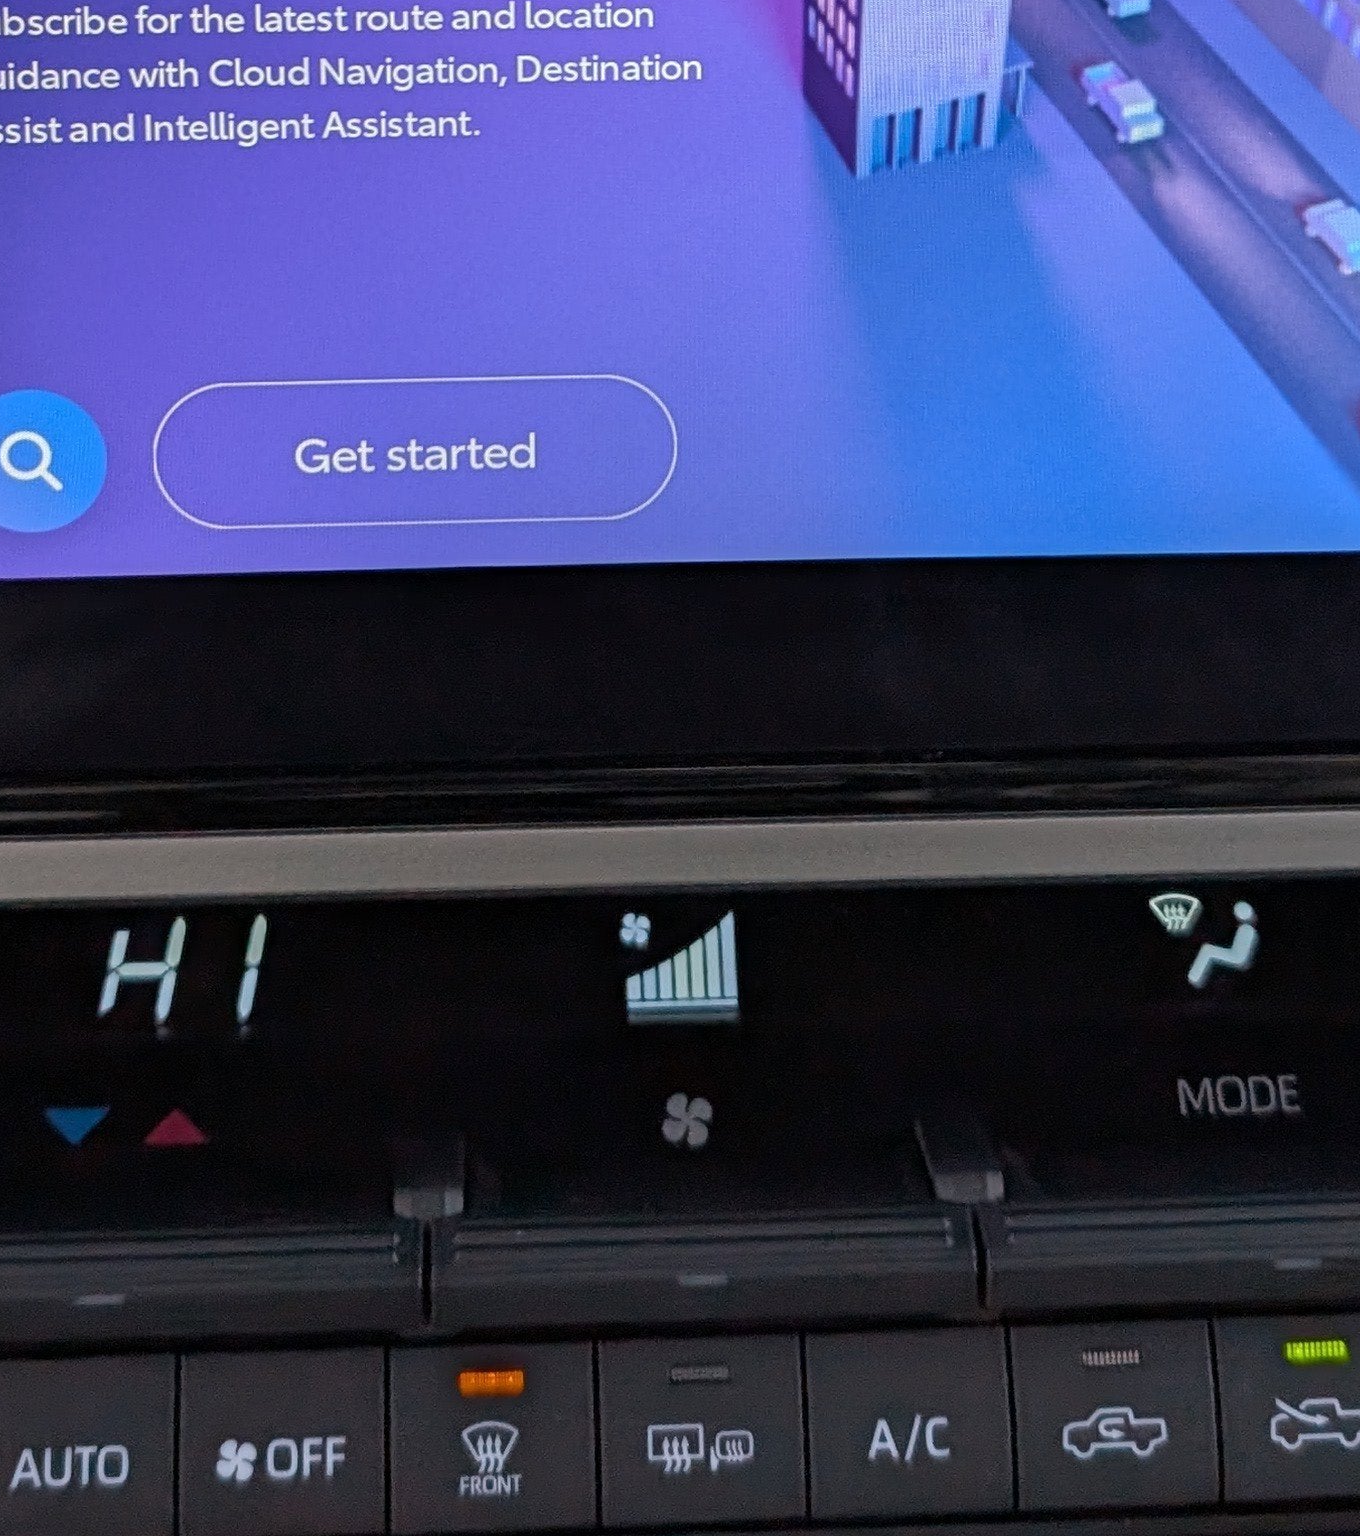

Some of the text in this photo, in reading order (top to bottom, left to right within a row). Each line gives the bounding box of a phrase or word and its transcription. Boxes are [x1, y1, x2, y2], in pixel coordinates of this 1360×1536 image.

[134, 4, 183, 34] for
[189, 3, 246, 34] the
[254, 3, 349, 33] latest
[355, 4, 444, 32] route
[451, 0, 516, 30] and
[525, 0, 654, 29] location
[128, 58, 199, 88] with
[209, 56, 310, 87] Cloud
[319, 56, 508, 92] Navigation,
[516, 53, 702, 83] Destination
[68, 112, 135, 143] and
[144, 111, 316, 148] Intelligent
[322, 110, 481, 139] Assistant.
[294, 431, 536, 474] Get started
[1177, 1073, 1301, 1117] MODE
[266, 1436, 346, 1480] OFF
[868, 1414, 950, 1461] A/C
[9, 1444, 130, 1490] AUTO
[459, 1473, 522, 1495] FRONT
